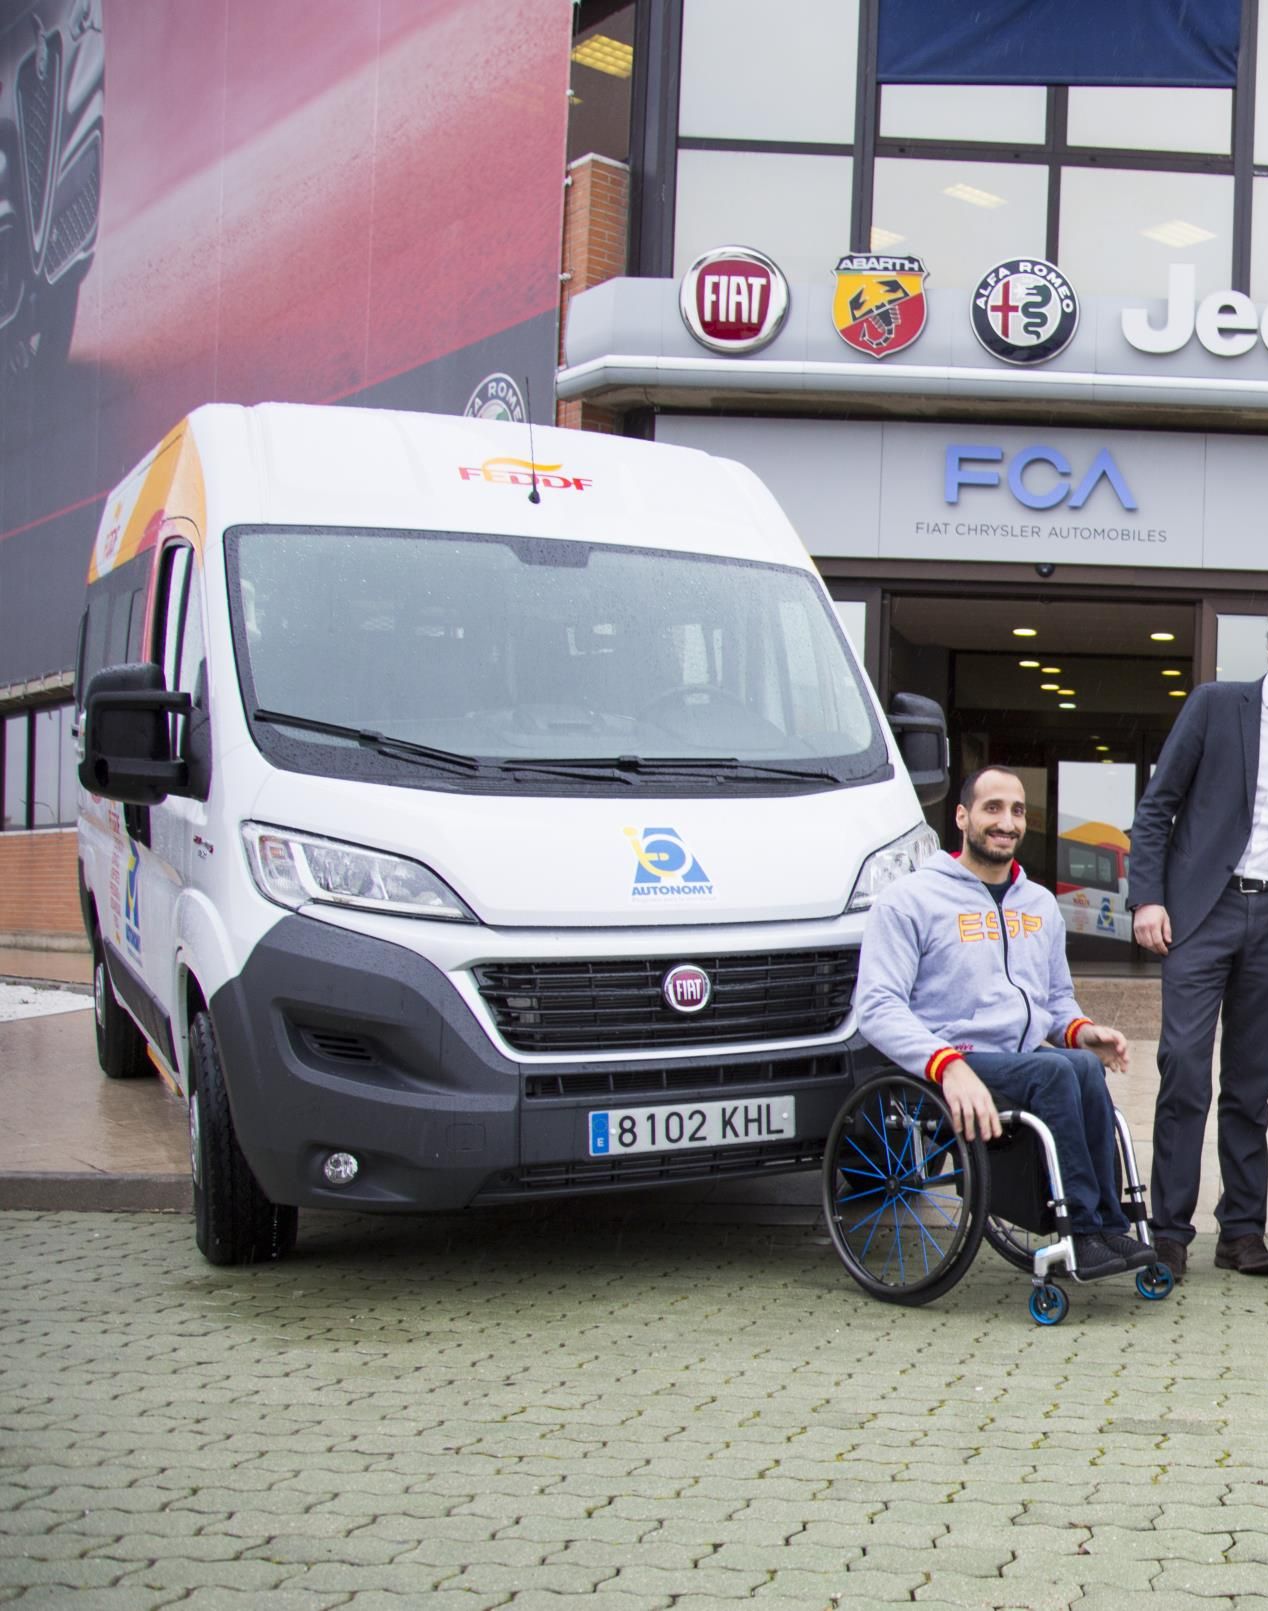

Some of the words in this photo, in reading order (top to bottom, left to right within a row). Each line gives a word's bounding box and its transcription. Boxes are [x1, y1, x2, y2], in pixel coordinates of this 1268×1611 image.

[838, 257, 919, 272] ABARTH
[703, 275, 767, 324] FIAT
[975, 266, 1011, 310] ALFA
[1018, 261, 1074, 313] ROMEO
[488, 381, 523, 422] ROME
[944, 444, 1138, 511] FCA
[915, 521, 950, 536] FIAT
[955, 523, 1042, 539] CHRYSLER
[1048, 526, 1168, 543] AUTOMOBILES
[631, 884, 713, 896] AUTONOMY
[675, 979, 702, 1001] FIAT
[617, 1109, 708, 1148] 8102
[720, 1103, 785, 1140] KHL
[596, 1137, 605, 1148] E
